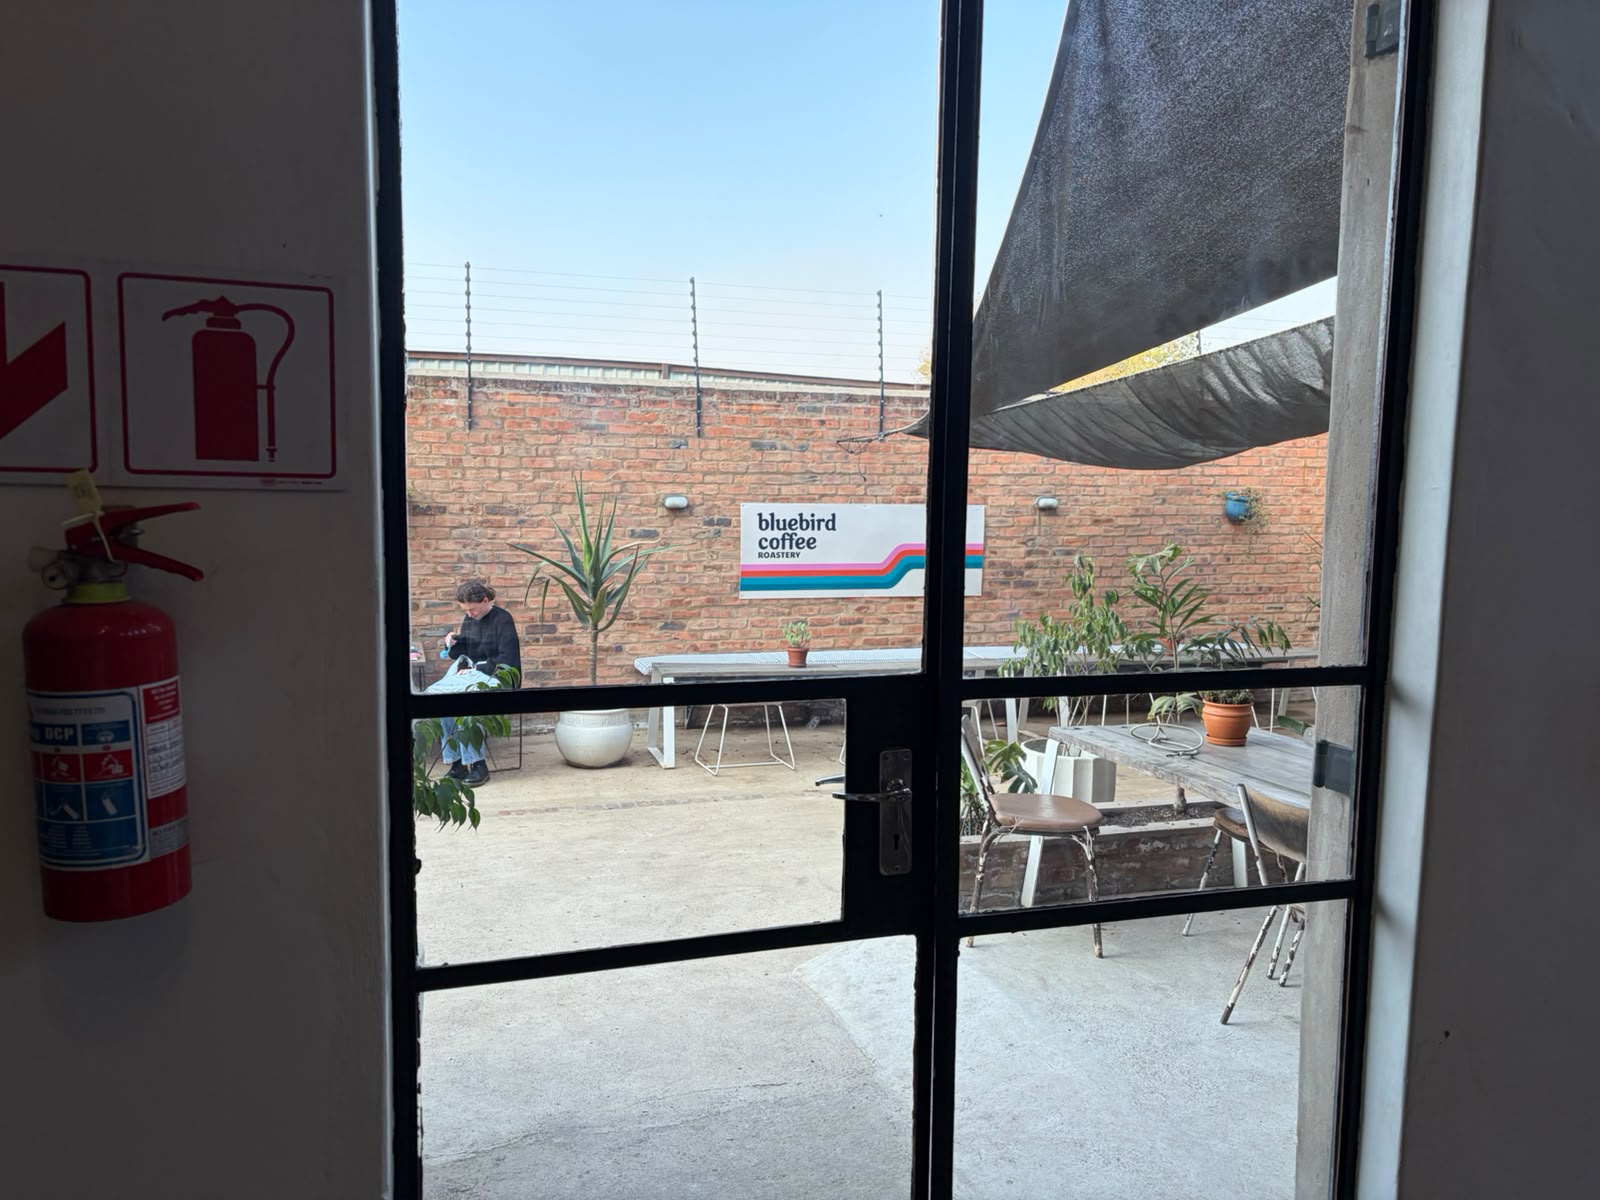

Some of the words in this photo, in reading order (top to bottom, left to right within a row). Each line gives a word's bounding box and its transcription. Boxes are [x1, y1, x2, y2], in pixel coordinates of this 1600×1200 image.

[757, 512, 836, 531] bluebird
[758, 532, 817, 550] coffee
[758, 551, 800, 559] ROASTERY
[45, 727, 74, 741] DCP
